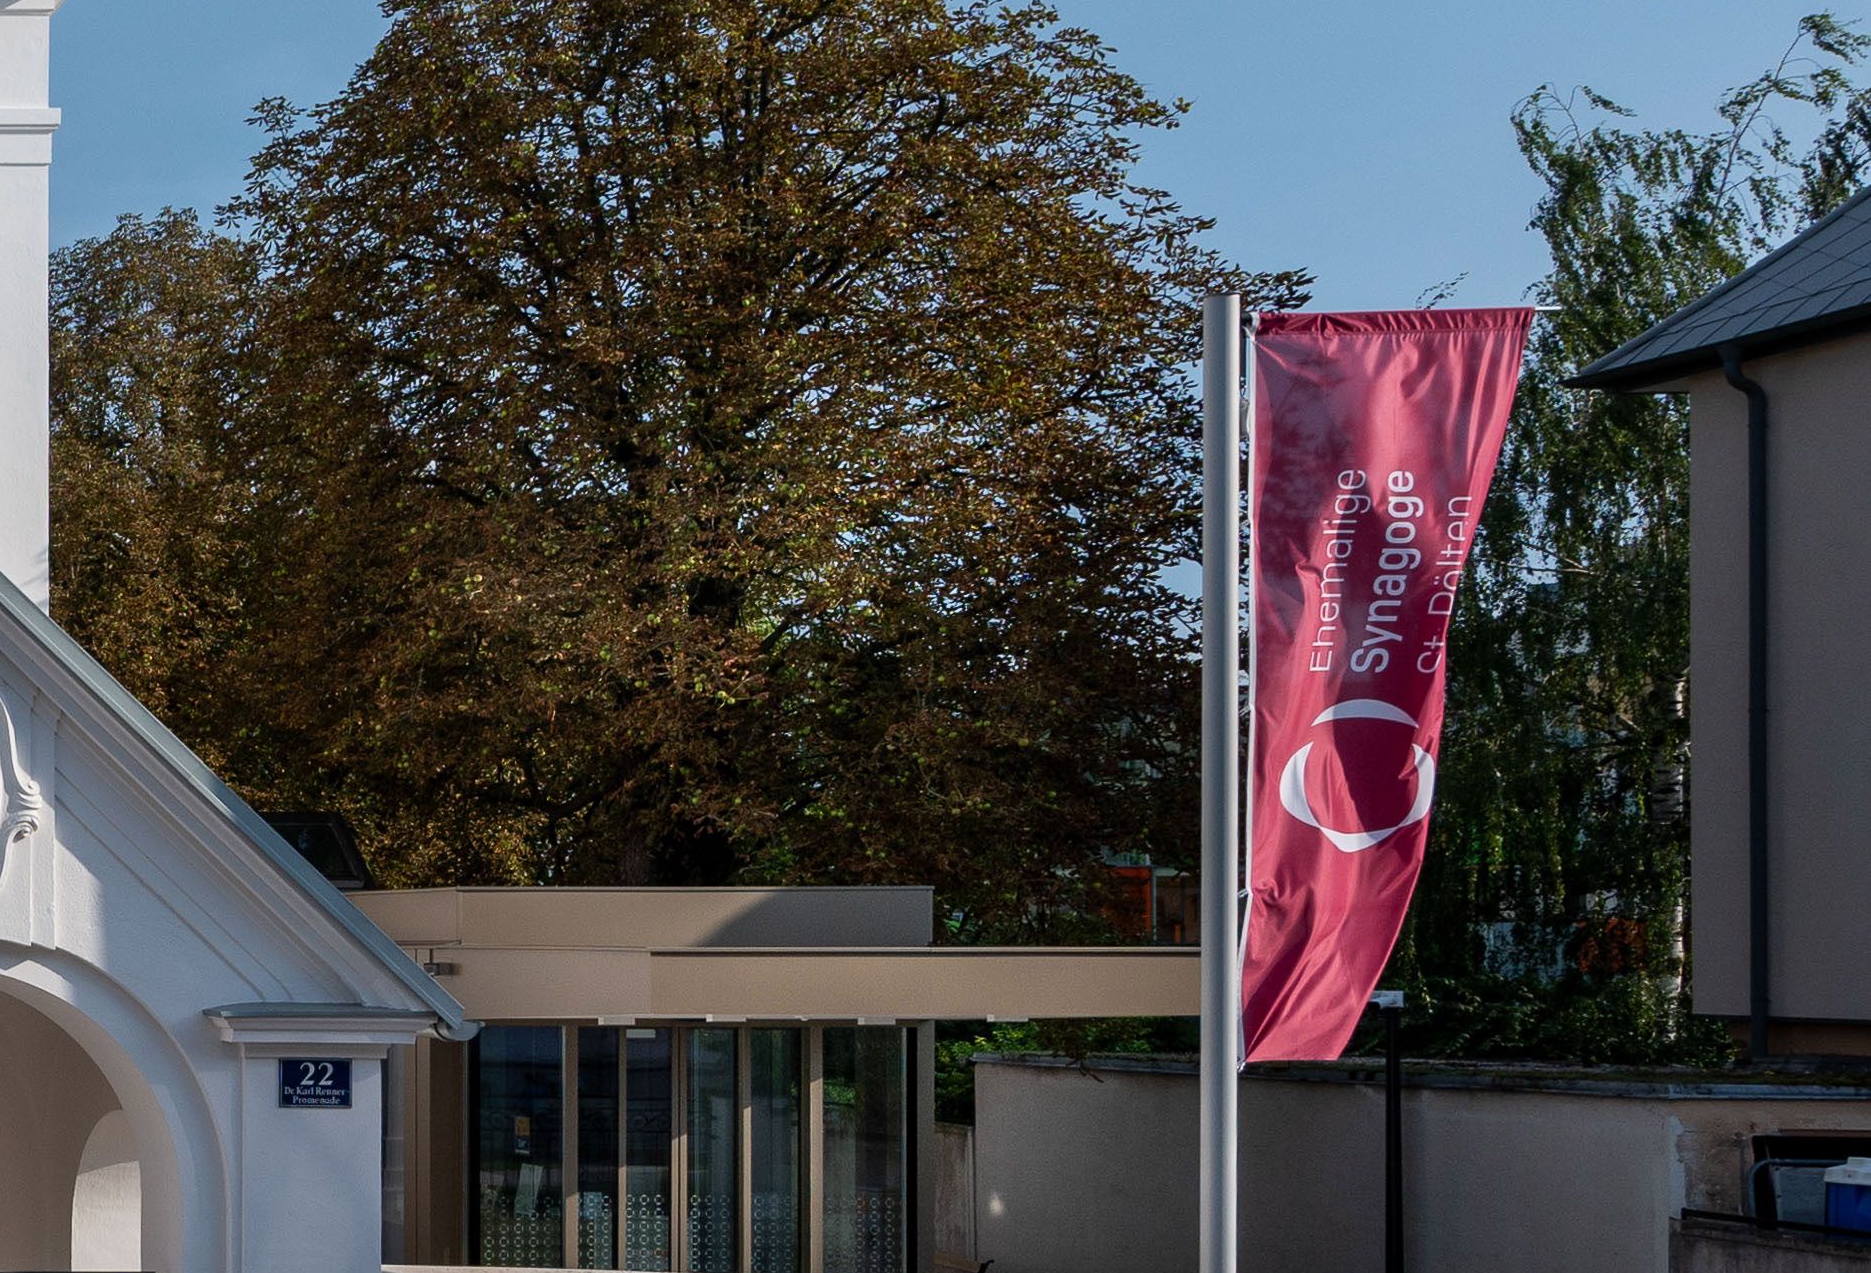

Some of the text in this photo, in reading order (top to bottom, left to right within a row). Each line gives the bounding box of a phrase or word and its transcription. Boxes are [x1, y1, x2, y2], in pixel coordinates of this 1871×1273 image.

[1309, 469, 1371, 672] Ehemalige
[1350, 470, 1424, 674] Synagoge
[299, 1062, 334, 1086] 22
[292, 1096, 340, 1105] Promenade
[296, 1086, 314, 1095] Karl
